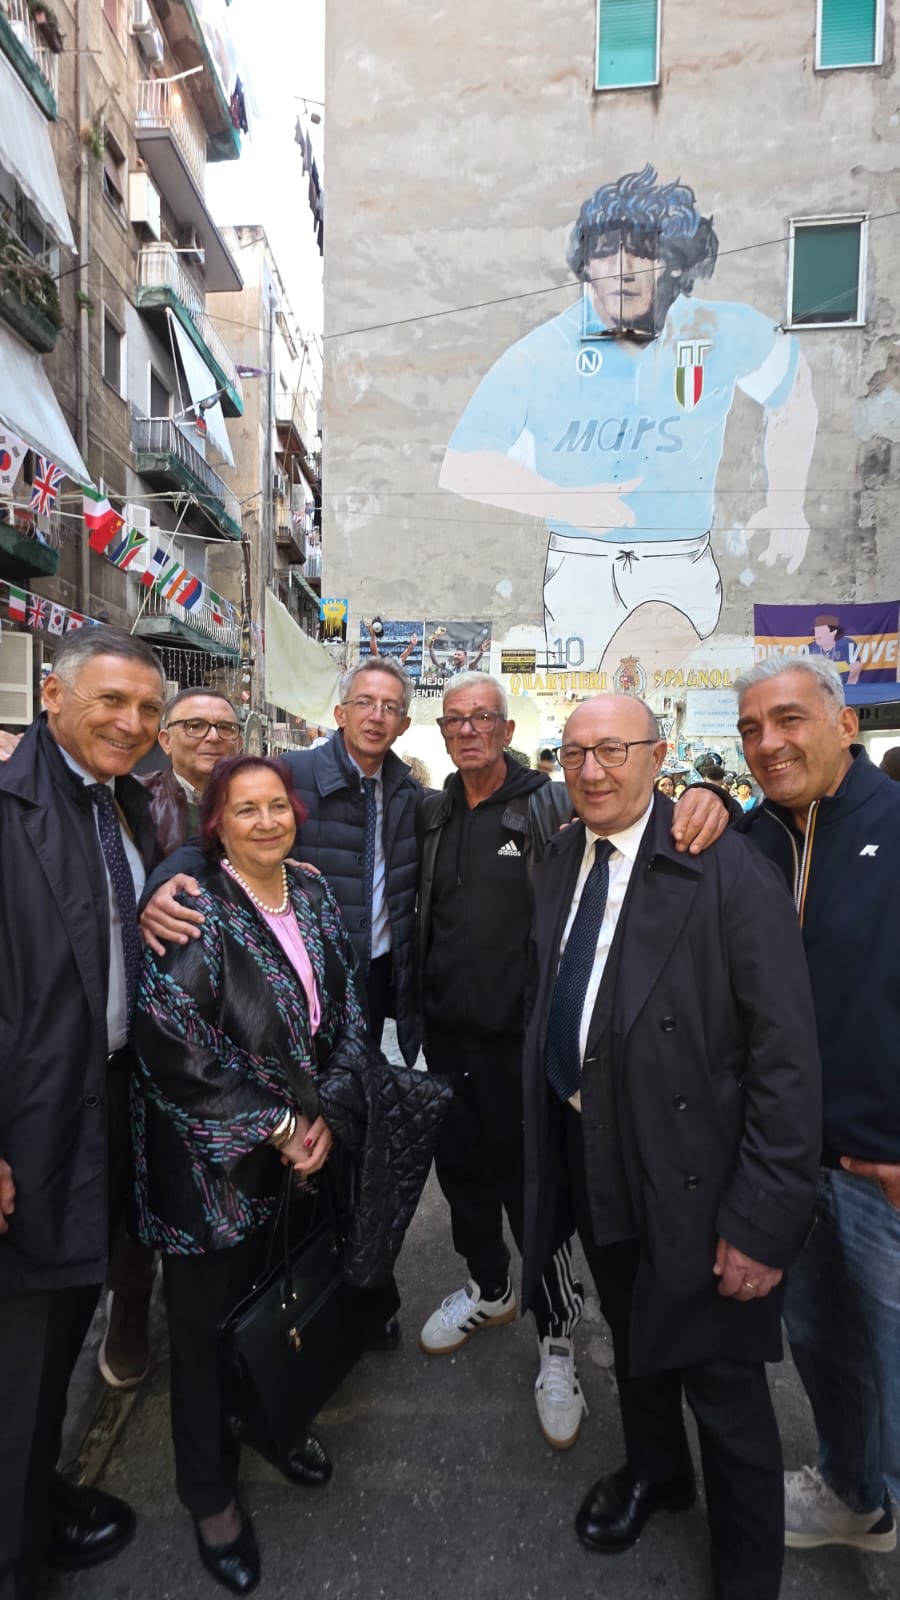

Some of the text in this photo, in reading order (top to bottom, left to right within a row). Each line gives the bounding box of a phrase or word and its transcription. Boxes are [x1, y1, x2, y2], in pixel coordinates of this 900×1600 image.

[553, 636, 585, 667] 10
[848, 640, 897, 664] VIVE
[510, 671, 607, 695] QUARTIERI
[497, 849, 521, 857] adidas
